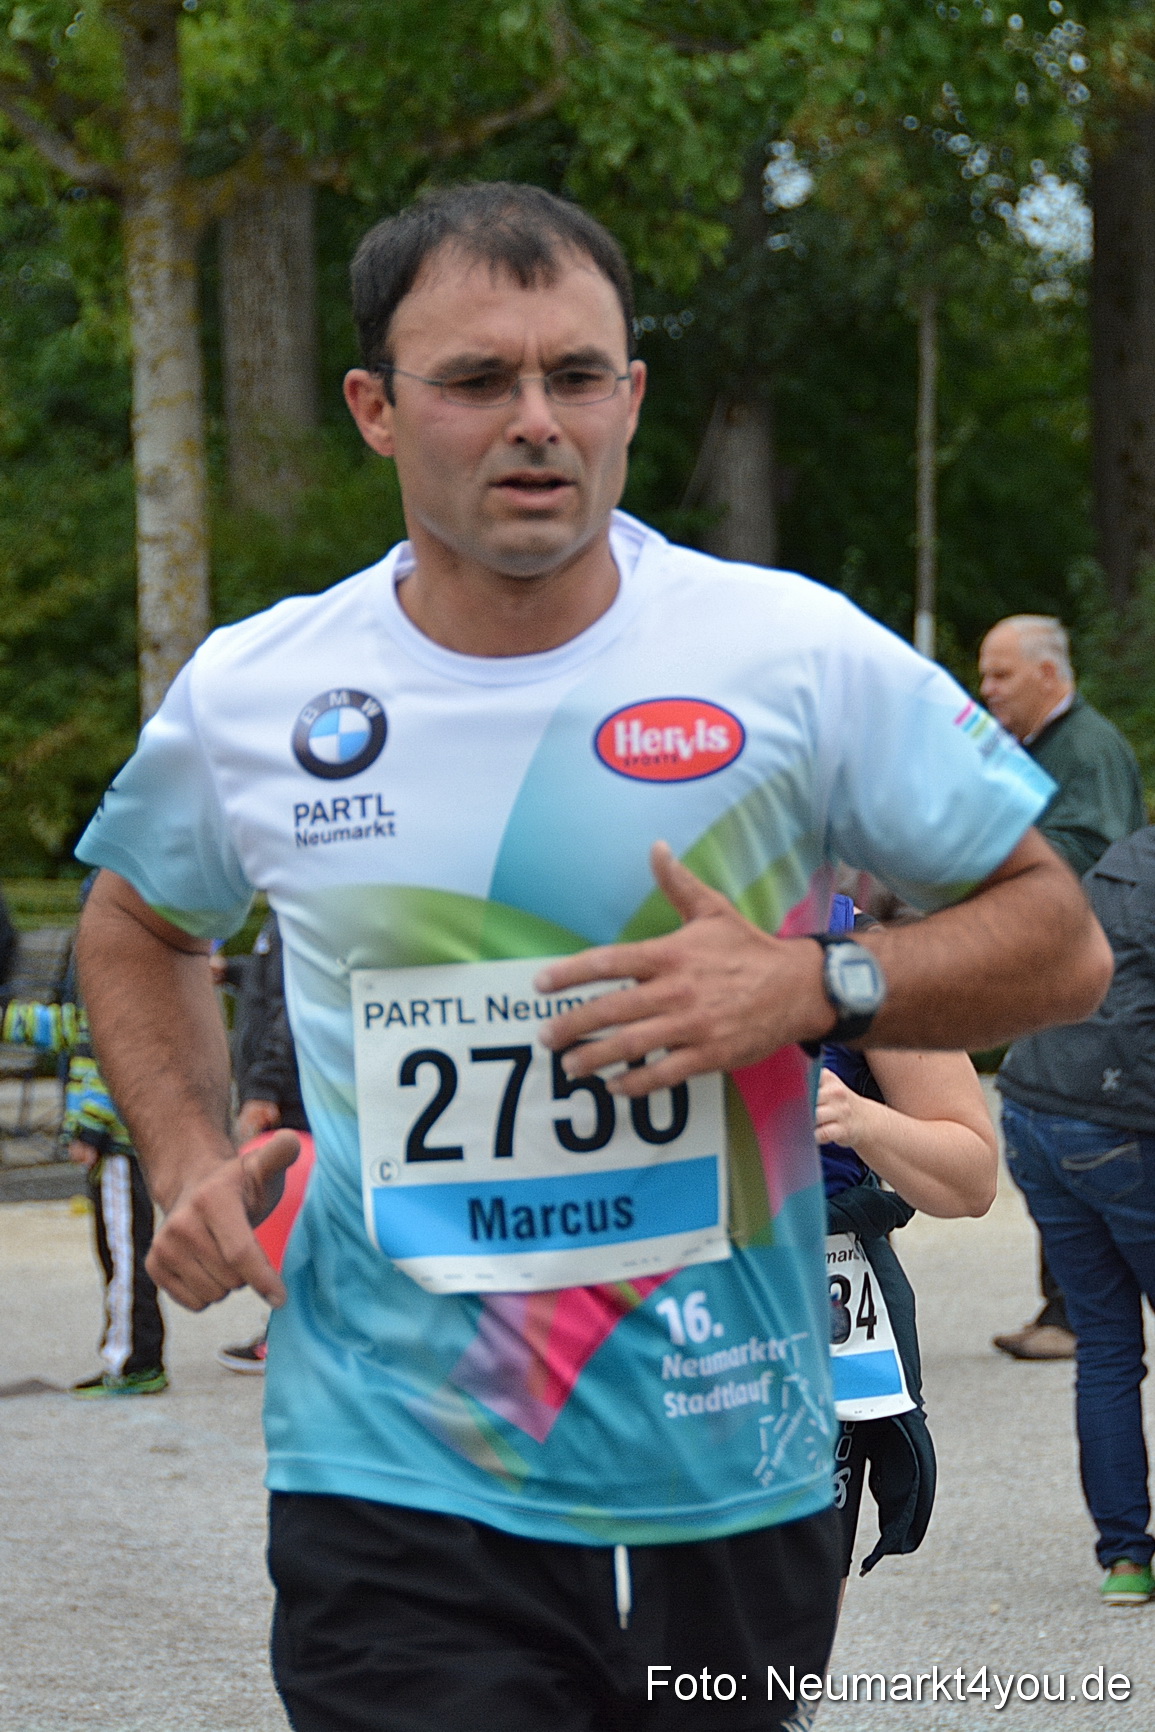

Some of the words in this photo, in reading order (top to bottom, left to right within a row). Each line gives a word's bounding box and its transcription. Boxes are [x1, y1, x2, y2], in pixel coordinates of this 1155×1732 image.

[301, 690, 382, 724] BMW
[615, 718, 730, 761] Hervis
[294, 794, 395, 826] PARTL
[296, 820, 395, 847] Neumarkt
[364, 996, 475, 1028] PARTL
[467, 1195, 635, 1241] Marcus
[655, 1290, 725, 1346] 16.
[662, 1336, 787, 1380] Neumarktr
[663, 1371, 774, 1418] Stadtlauf
